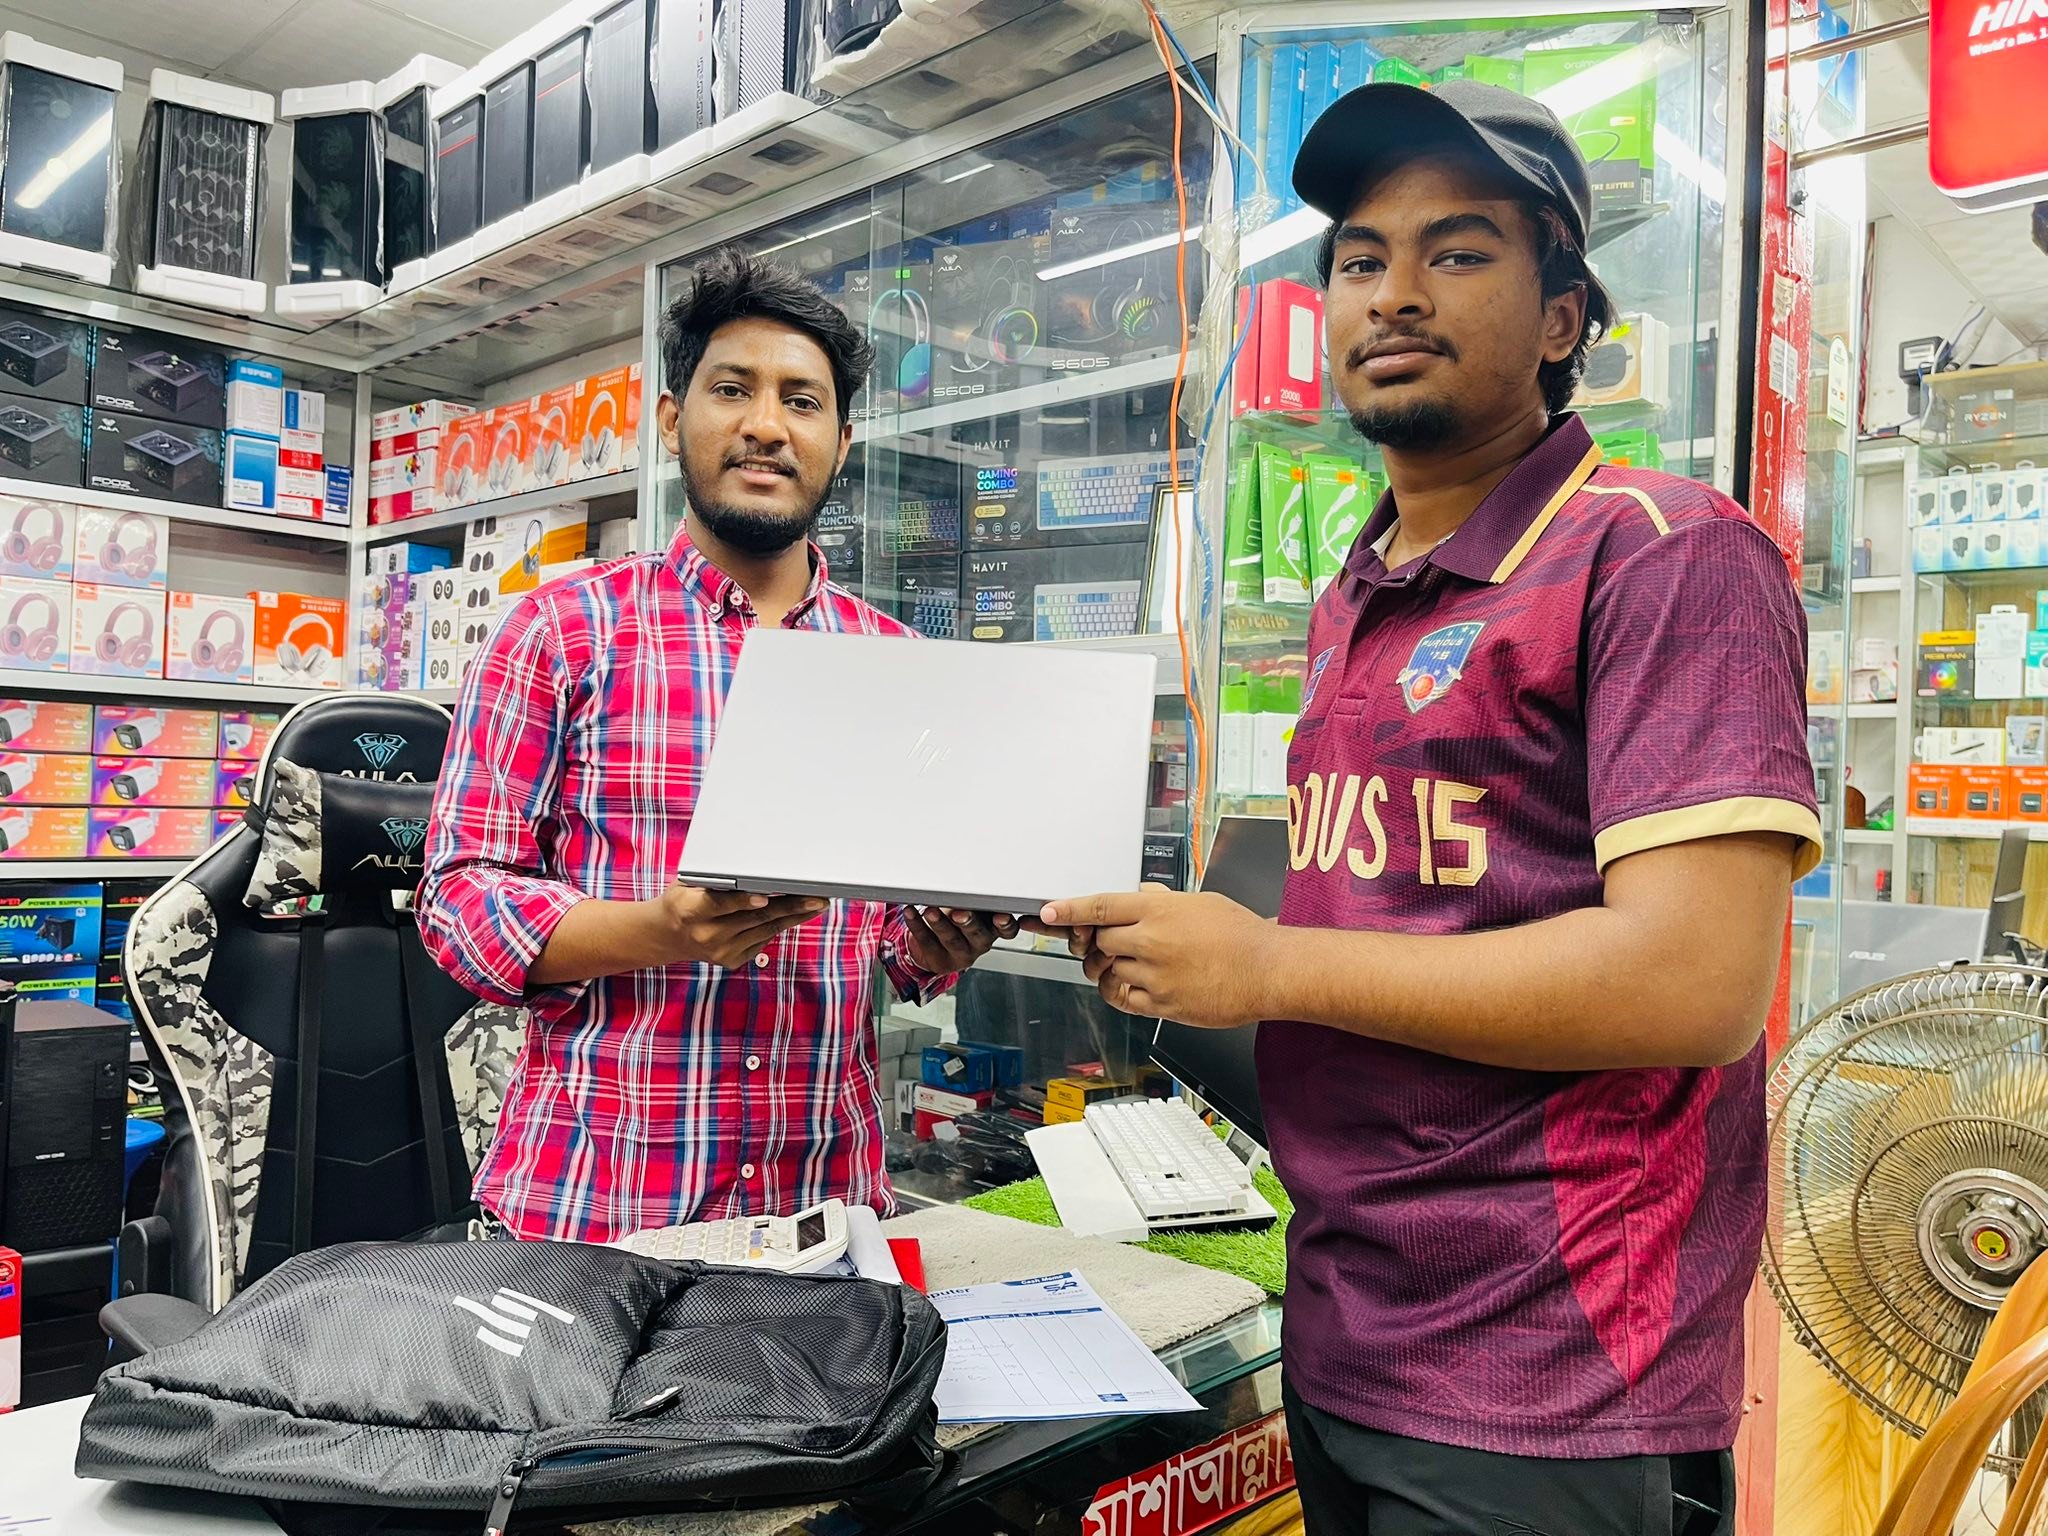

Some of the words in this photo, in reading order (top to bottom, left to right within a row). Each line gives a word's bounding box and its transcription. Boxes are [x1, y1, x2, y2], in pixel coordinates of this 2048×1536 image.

[1056, 228, 1085, 236] AULA
[937, 265, 963, 273] AULA
[1051, 356, 1111, 371] S605
[933, 384, 985, 397] S608
[1964, 411, 2007, 423] RYZEN
[974, 439, 1010, 452] HAVIT
[977, 468, 1018, 480] GAMING
[977, 479, 1016, 491] COMBO
[818, 514, 865, 526] FUNCTION
[972, 562, 1008, 573] HAVIT
[975, 591, 1016, 601] GAMING
[975, 601, 1013, 611] COMBO
[1412, 778, 1489, 887] 15
[350, 854, 425, 875] AUL
[1848, 950, 1886, 961] ASUS
[52, 980, 82, 988] SUPPLY
[1021, 1277, 1041, 1286] Cash
[1041, 1273, 1064, 1283] Memo
[1084, 1411, 1293, 1536] মাশাআল্লা
